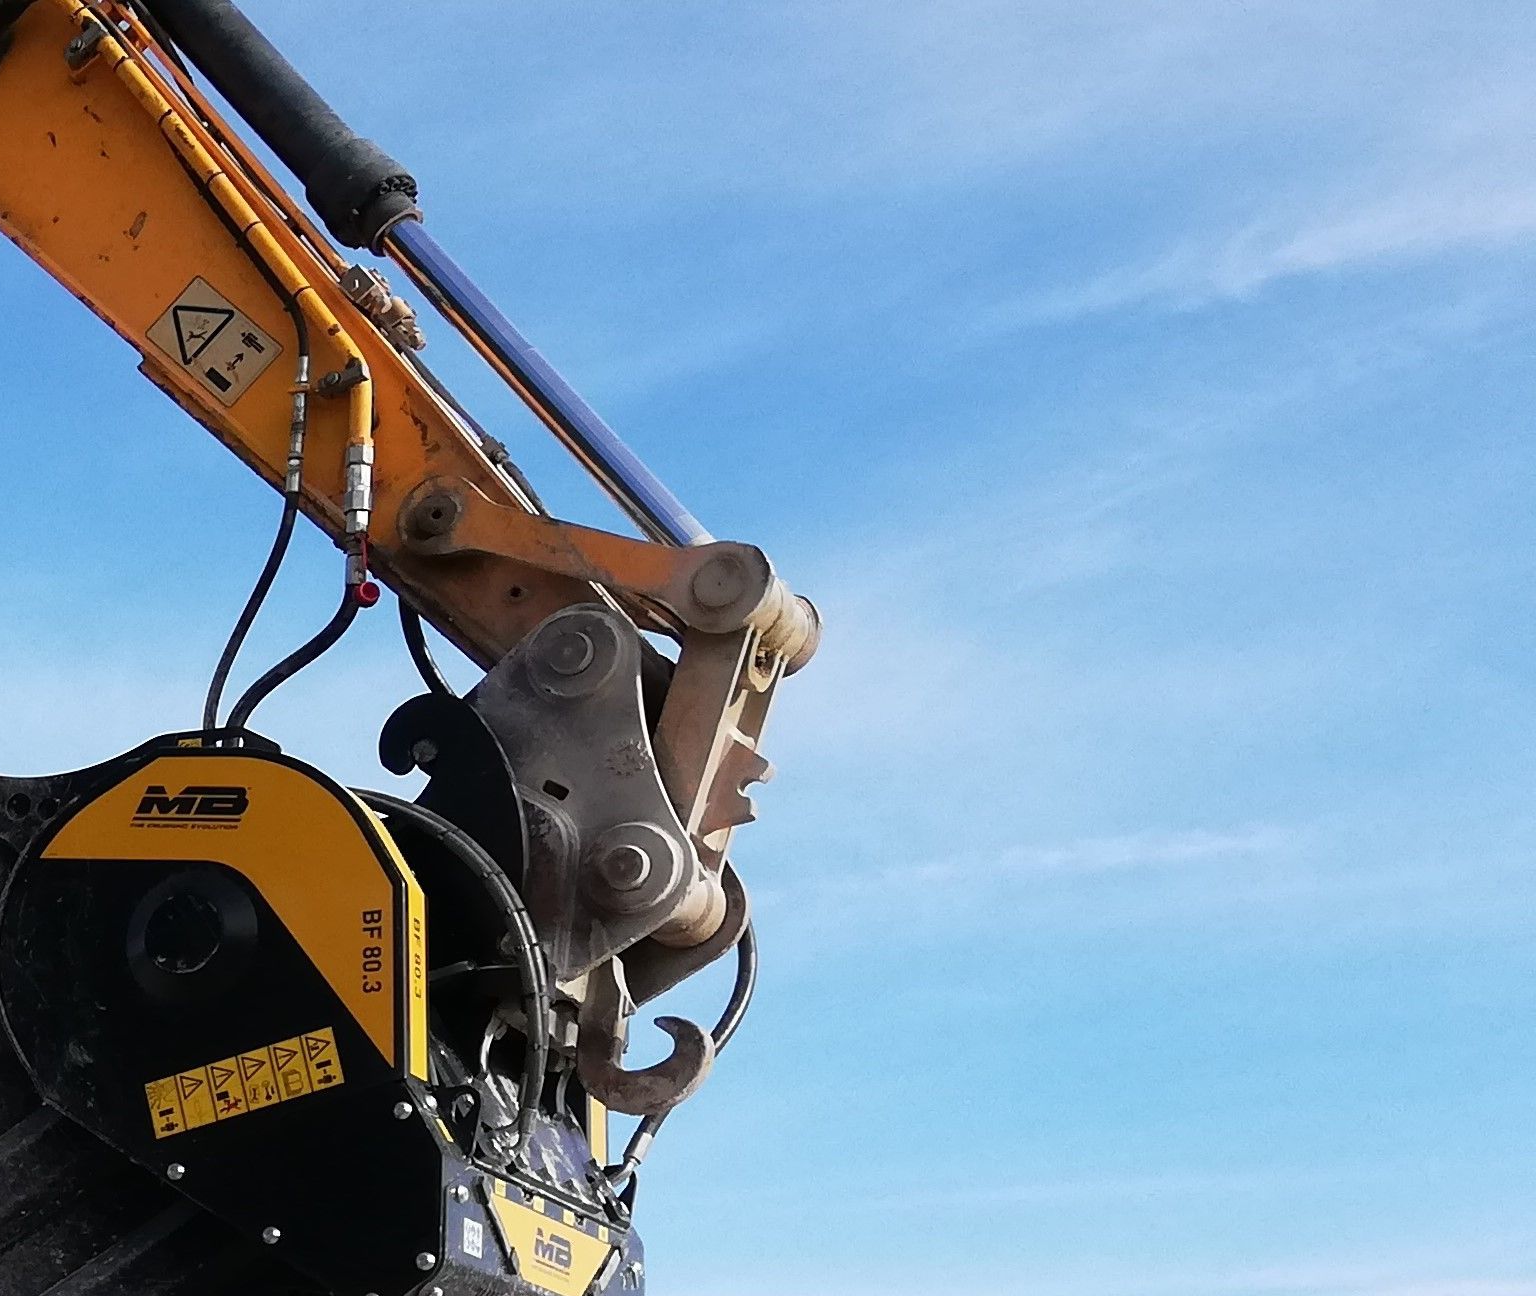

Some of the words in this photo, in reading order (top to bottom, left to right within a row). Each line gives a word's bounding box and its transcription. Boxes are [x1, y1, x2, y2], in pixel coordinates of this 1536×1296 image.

[135, 785, 249, 815] MB
[362, 909, 382, 939] BF
[362, 946, 382, 993] 80.3
[534, 1227, 572, 1270] MB
